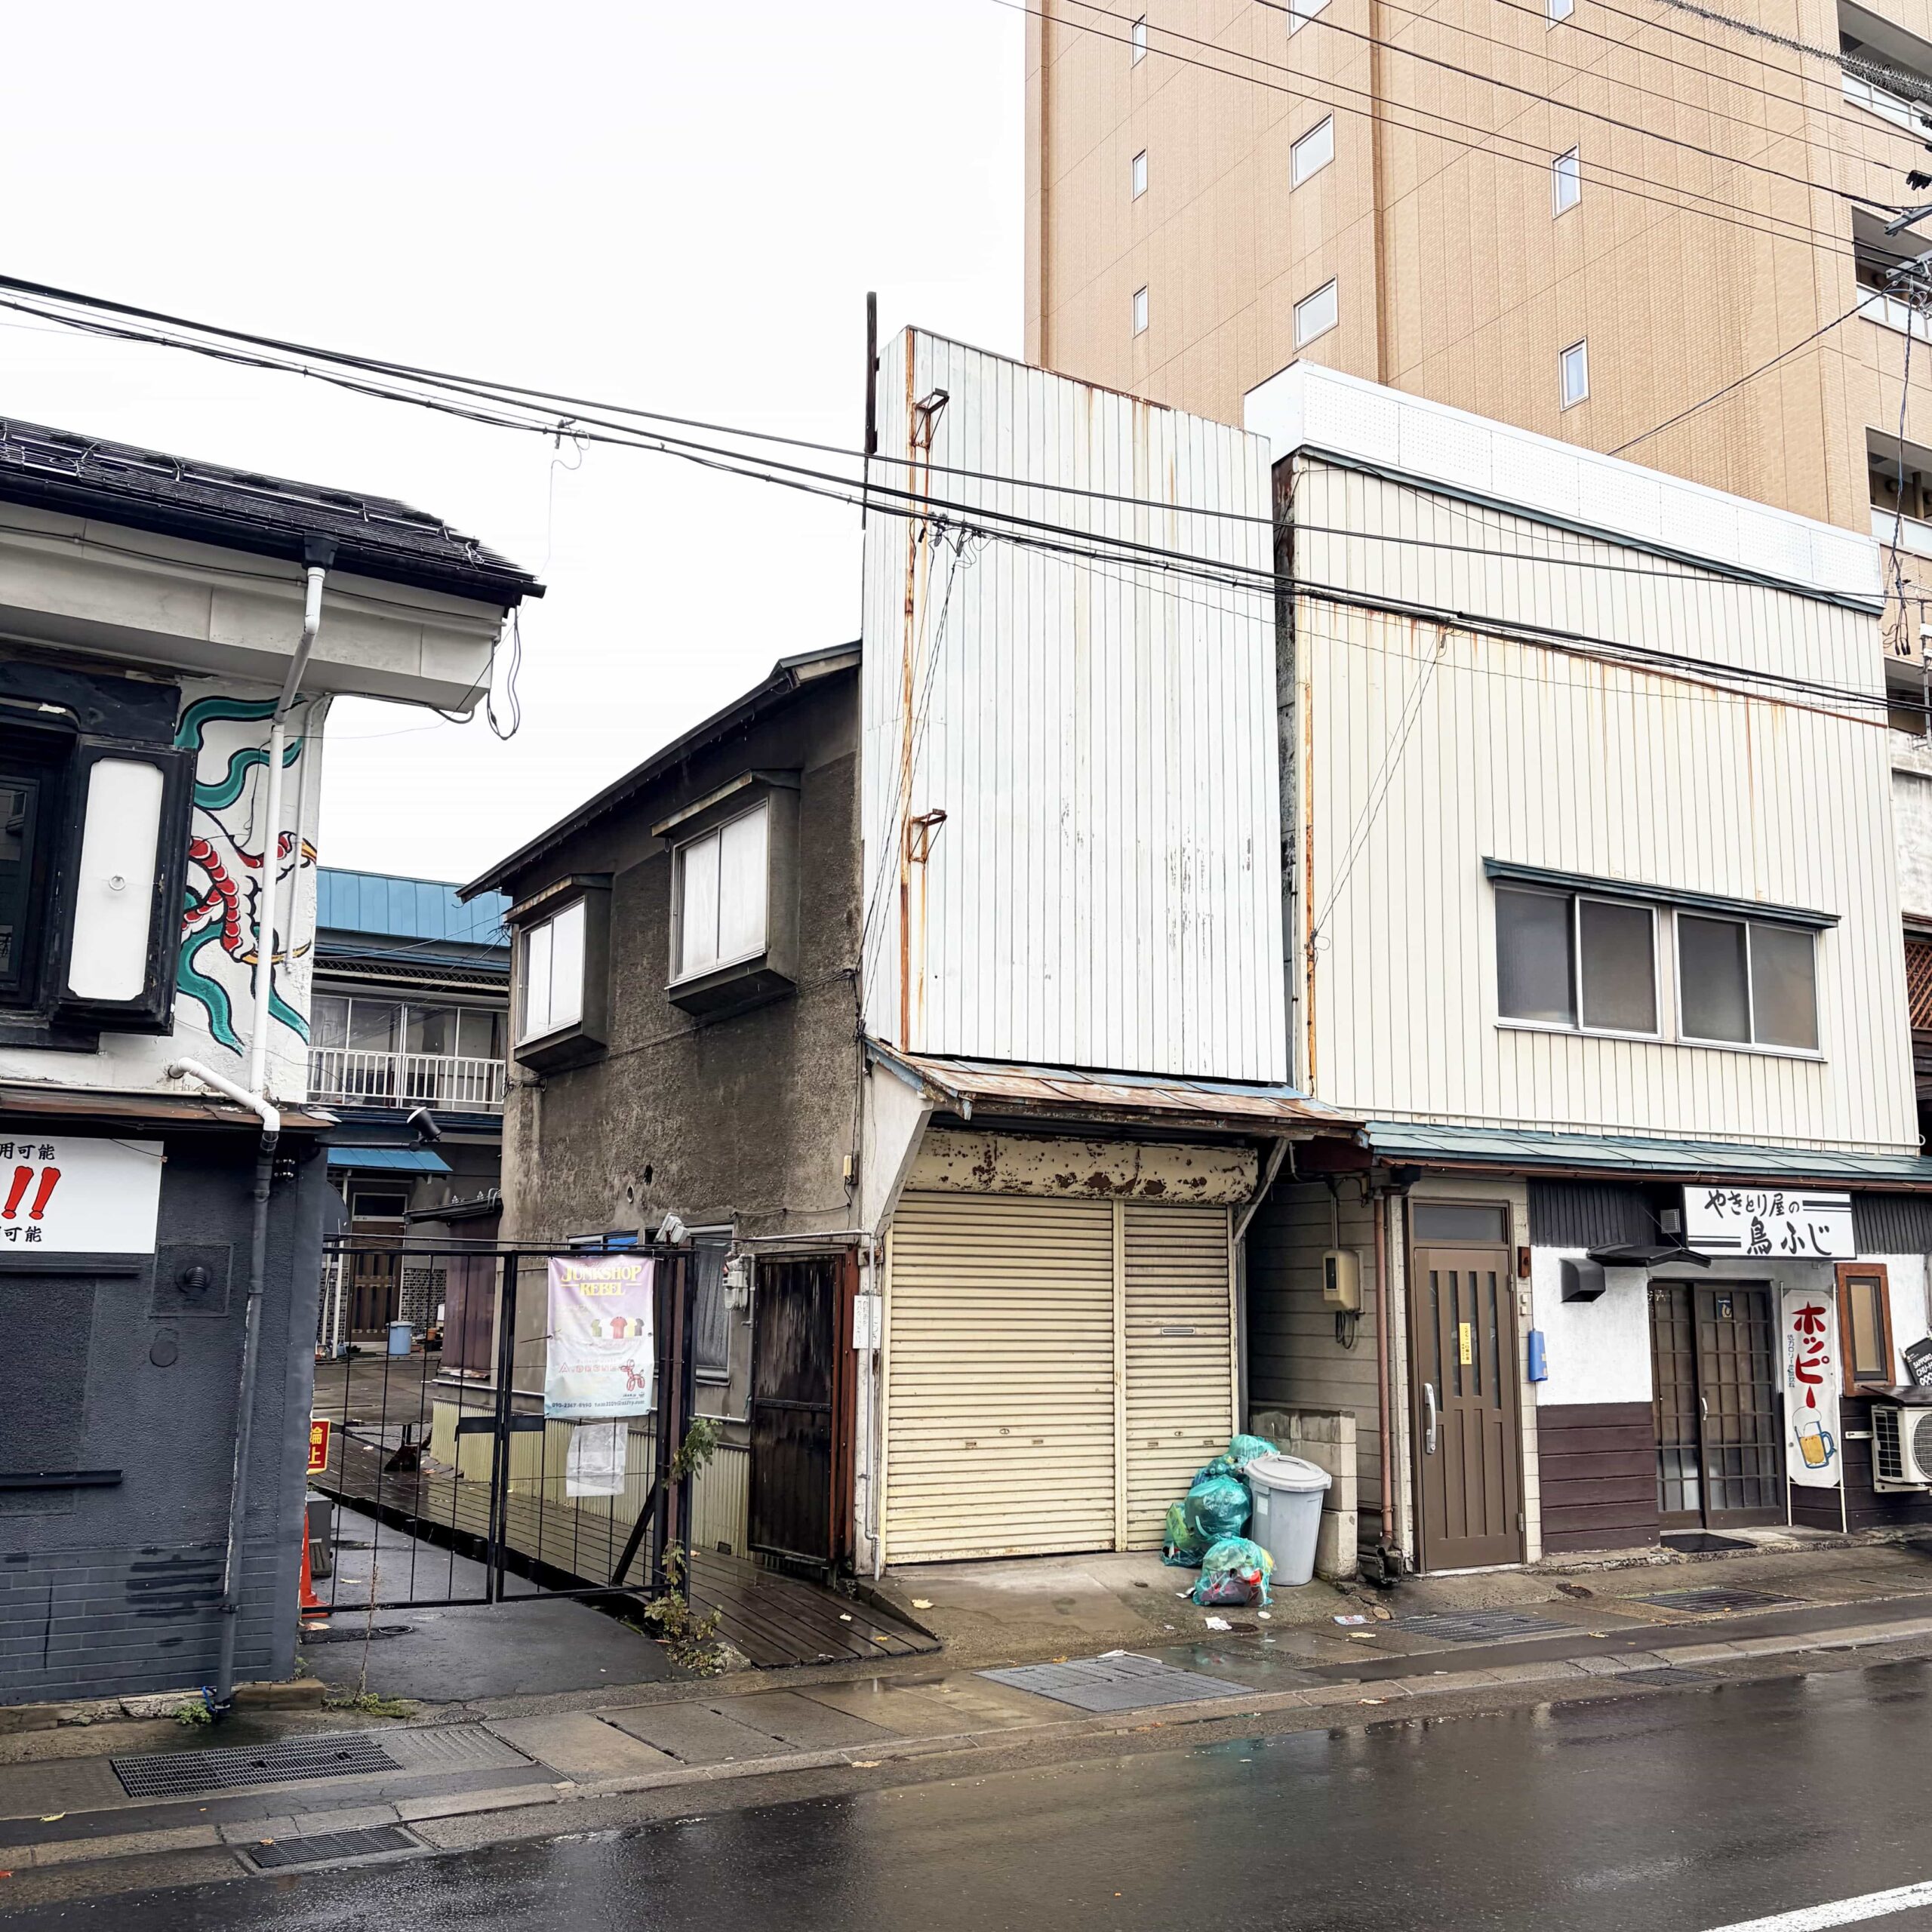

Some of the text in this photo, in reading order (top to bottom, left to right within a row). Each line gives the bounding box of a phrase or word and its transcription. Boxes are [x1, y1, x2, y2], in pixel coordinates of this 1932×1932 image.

[1704, 1189, 1800, 1218] やきとり屋の
[0, 1226, 42, 1243] 可能
[1746, 1216, 1832, 1256] 鳥ふじ
[561, 1265, 642, 1282] JUNKSHOP
[580, 1282, 626, 1296] REBEL
[1791, 1301, 1830, 1409] ホッピー
